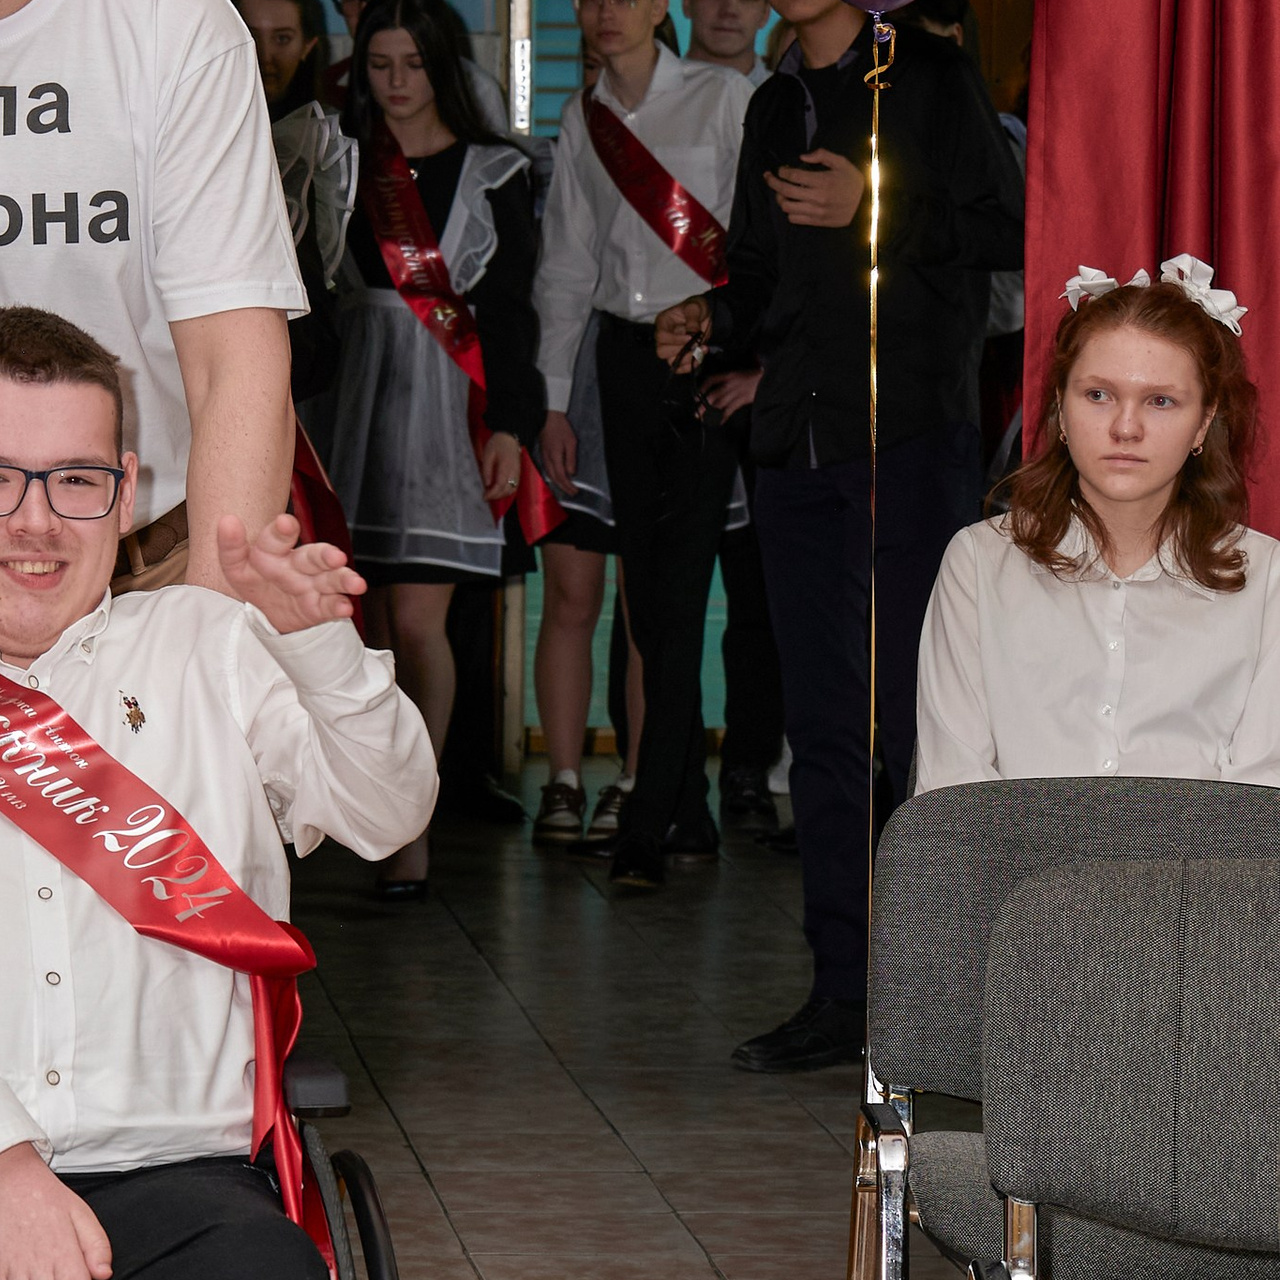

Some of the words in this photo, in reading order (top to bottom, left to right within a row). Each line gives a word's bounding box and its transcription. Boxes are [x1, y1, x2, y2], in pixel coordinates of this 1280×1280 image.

[36, 722, 89, 770] Антон
[0, 789, 27, 810] 1413
[92, 804, 233, 923] 2024
